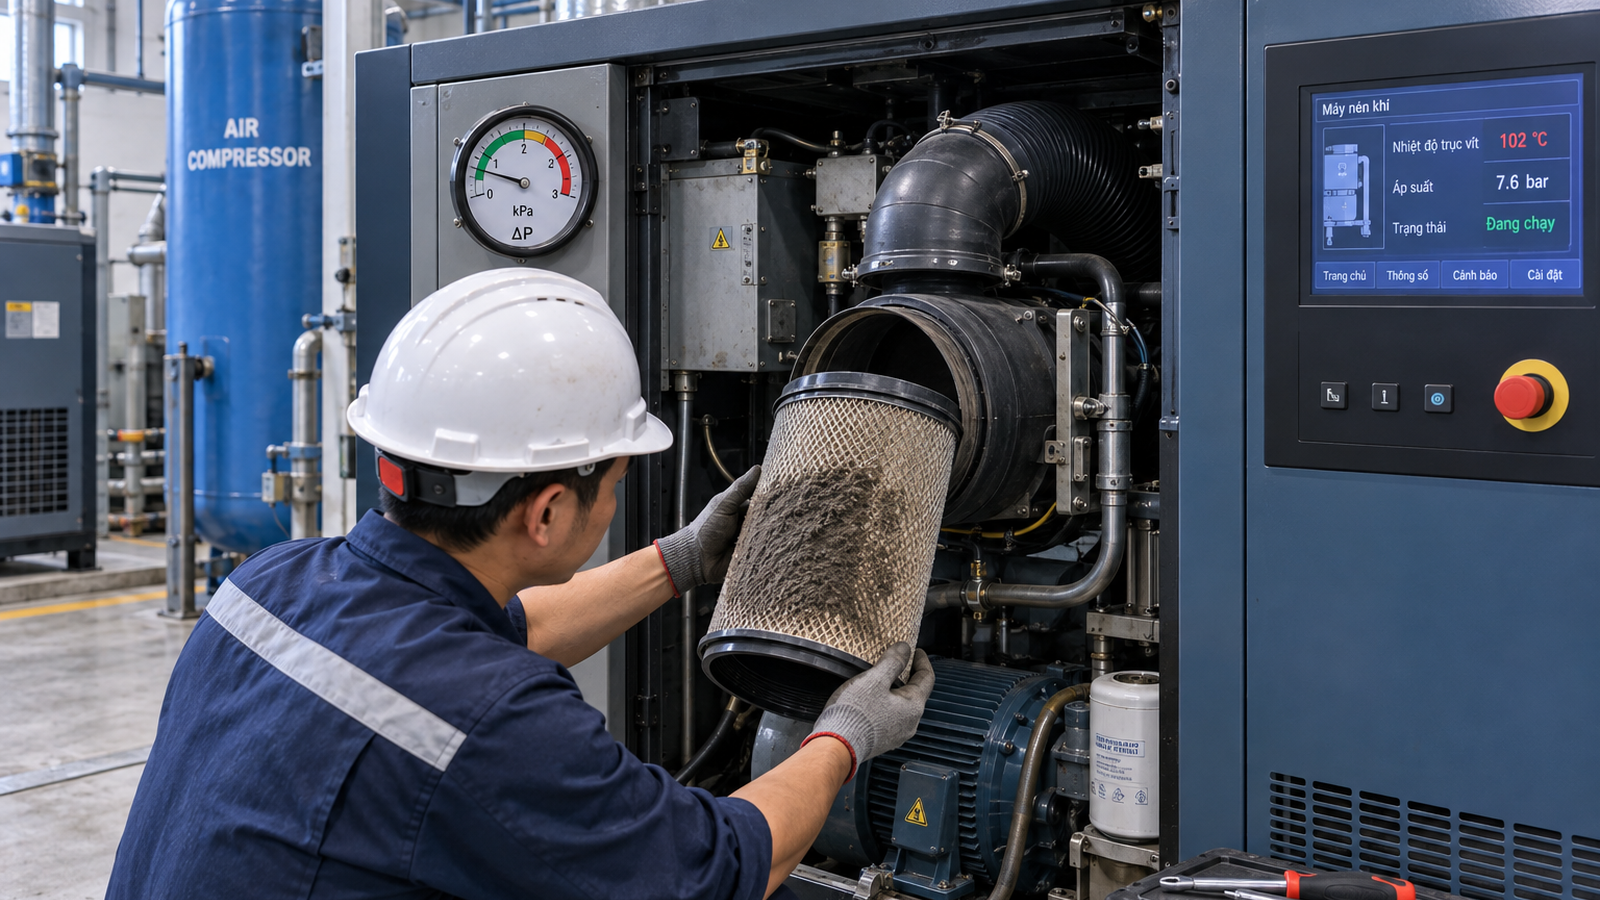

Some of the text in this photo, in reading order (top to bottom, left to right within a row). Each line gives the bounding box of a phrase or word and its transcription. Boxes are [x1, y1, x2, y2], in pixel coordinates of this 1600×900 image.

[1323, 99, 1389, 117] Máy nén khí
[223, 117, 260, 139] AIR
[1393, 137, 1479, 154] Nhiệt độ trục vít
[1500, 131, 1547, 148] 102 °C
[520, 143, 527, 155] 2
[187, 146, 312, 171] COMPRESSOR
[548, 158, 555, 169] 2
[1393, 180, 1407, 196] Áp
[1496, 174, 1549, 190] 7.6 bar
[487, 189, 493, 199] 0
[552, 189, 558, 199] 3
[513, 205, 533, 217] kPa
[1393, 222, 1422, 236] Trạng
[1486, 216, 1555, 233] Đang chạy
[512, 227, 533, 240] ΔP
[1323, 271, 1347, 283] Trang
[1480, 270, 1497, 280] báo
[1528, 269, 1543, 280] Cài
